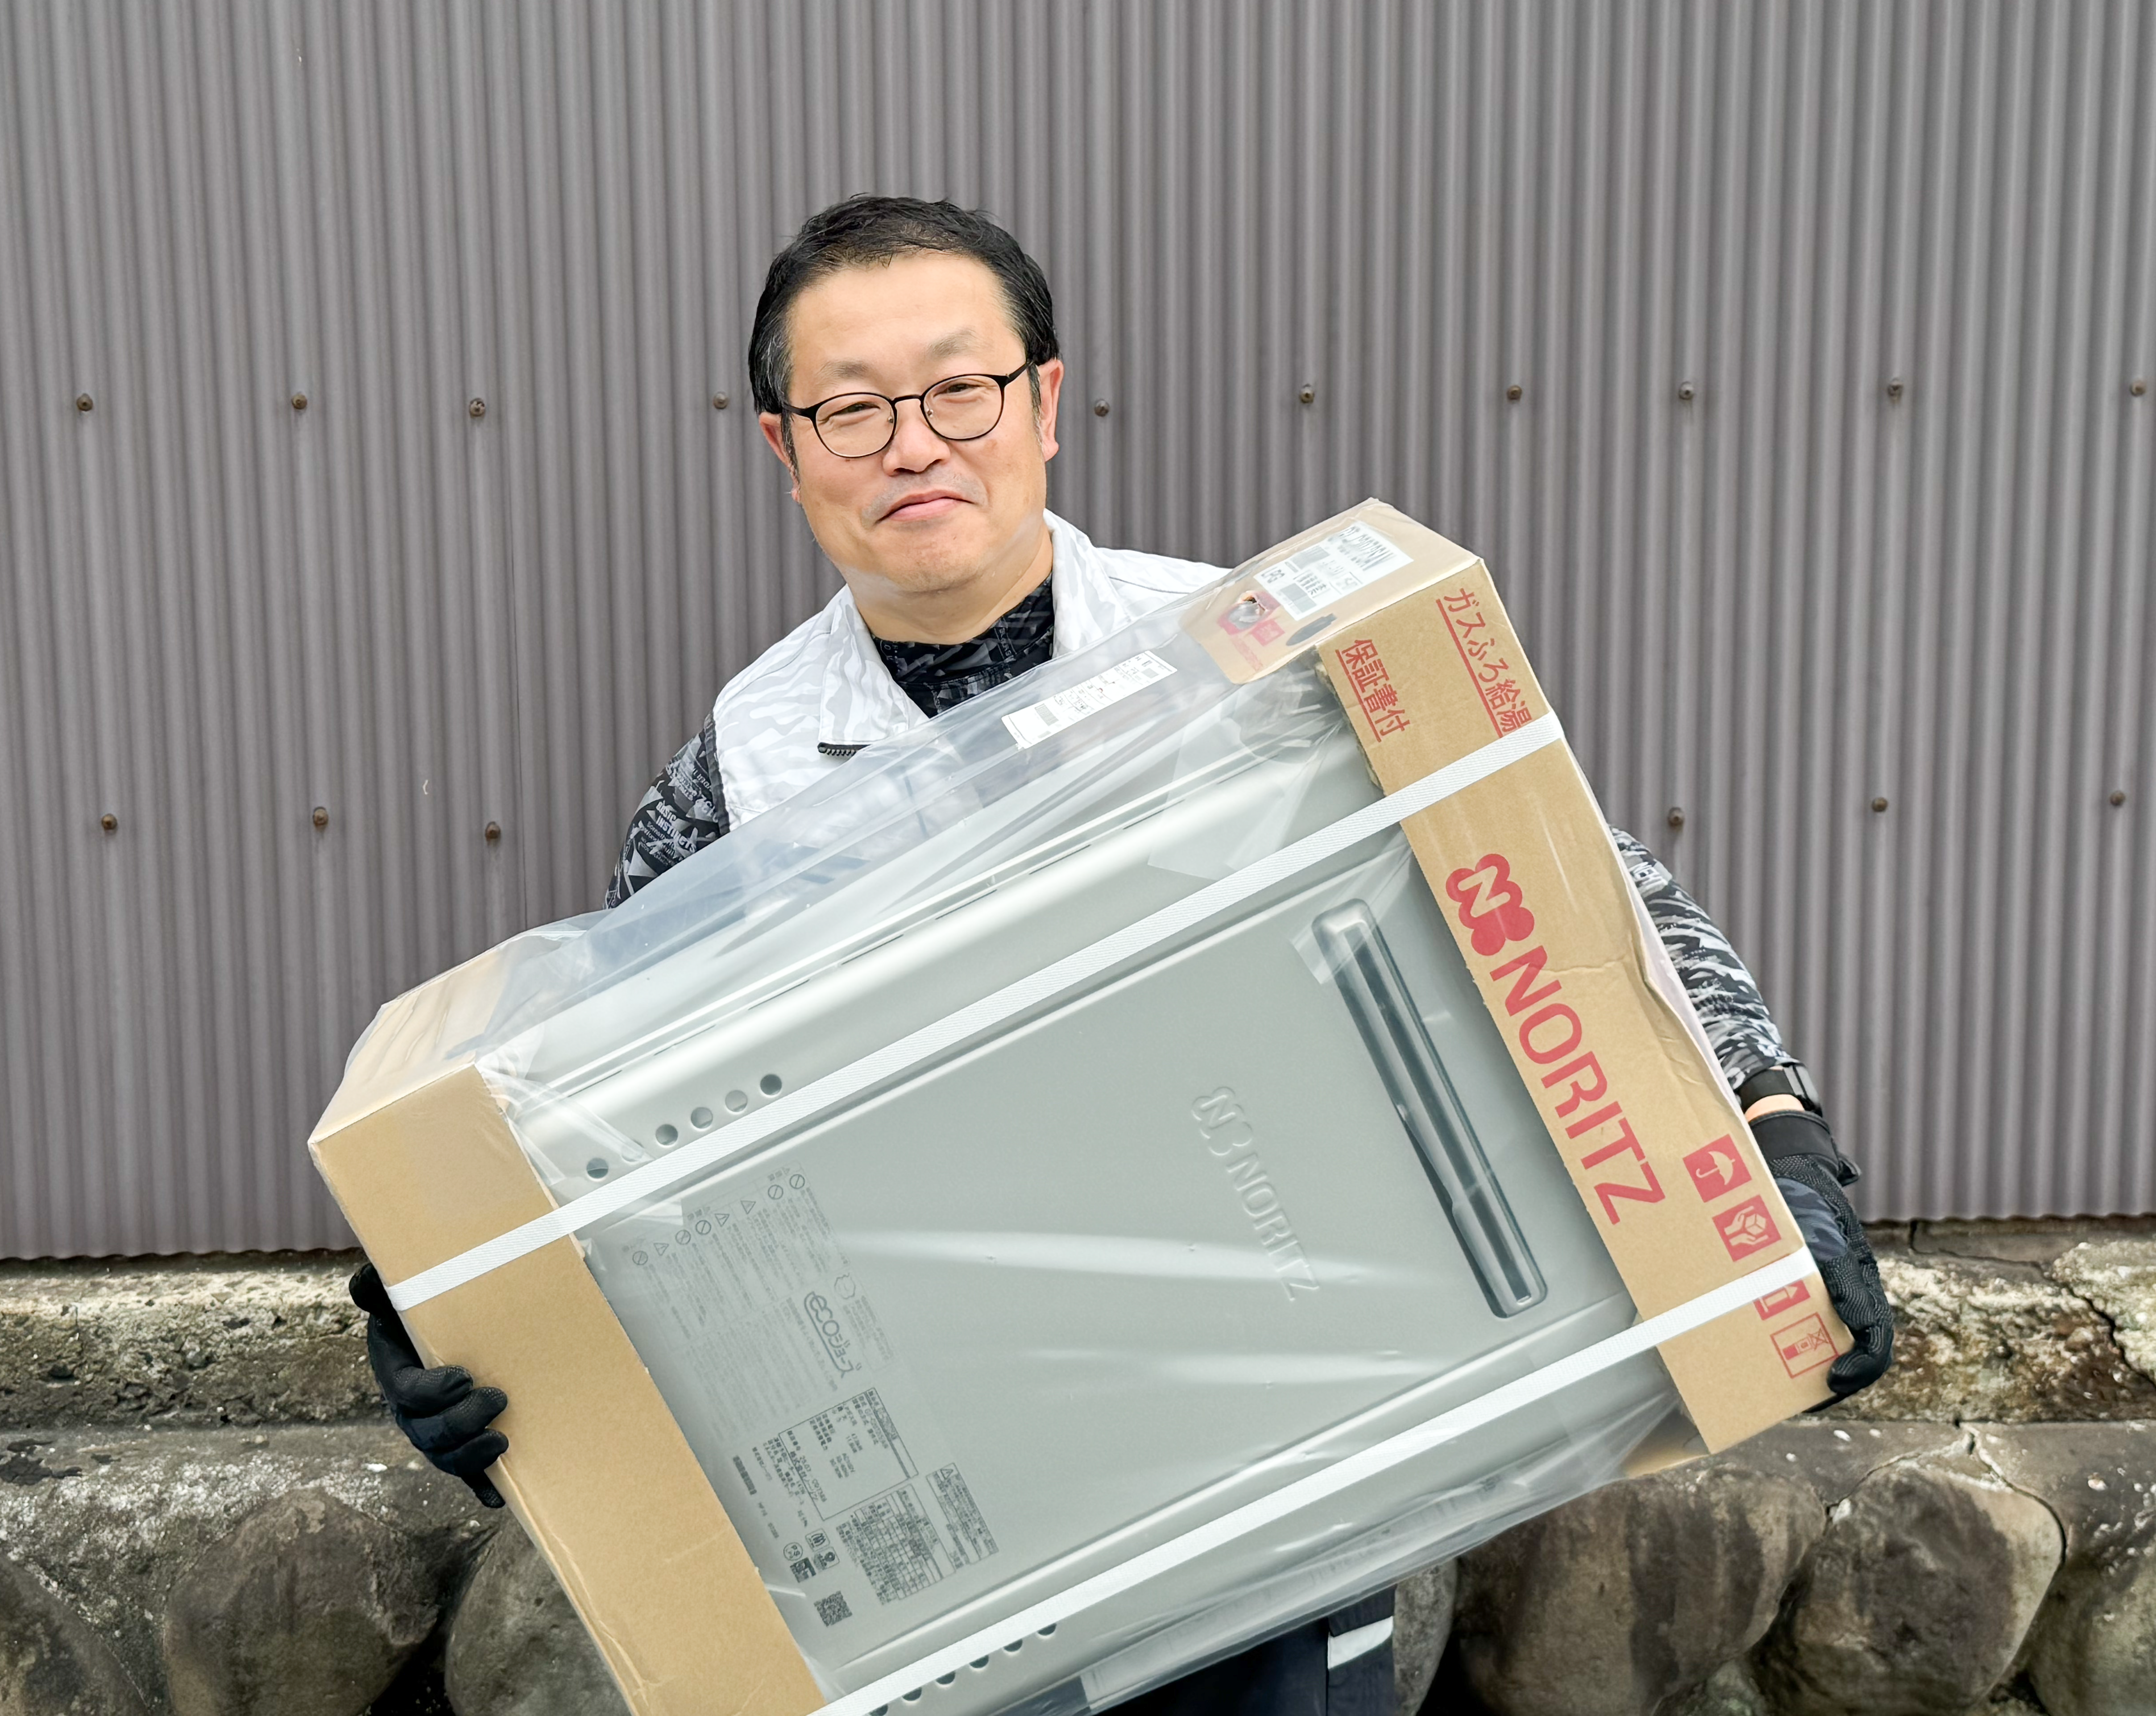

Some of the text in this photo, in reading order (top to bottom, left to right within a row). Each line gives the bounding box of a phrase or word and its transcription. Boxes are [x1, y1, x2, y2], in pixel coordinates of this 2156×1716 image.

[1341, 639, 1410, 737] 保証書付
[1489, 945, 1666, 1225] NORITZ
[1226, 1152, 1320, 1302] NORITZ
